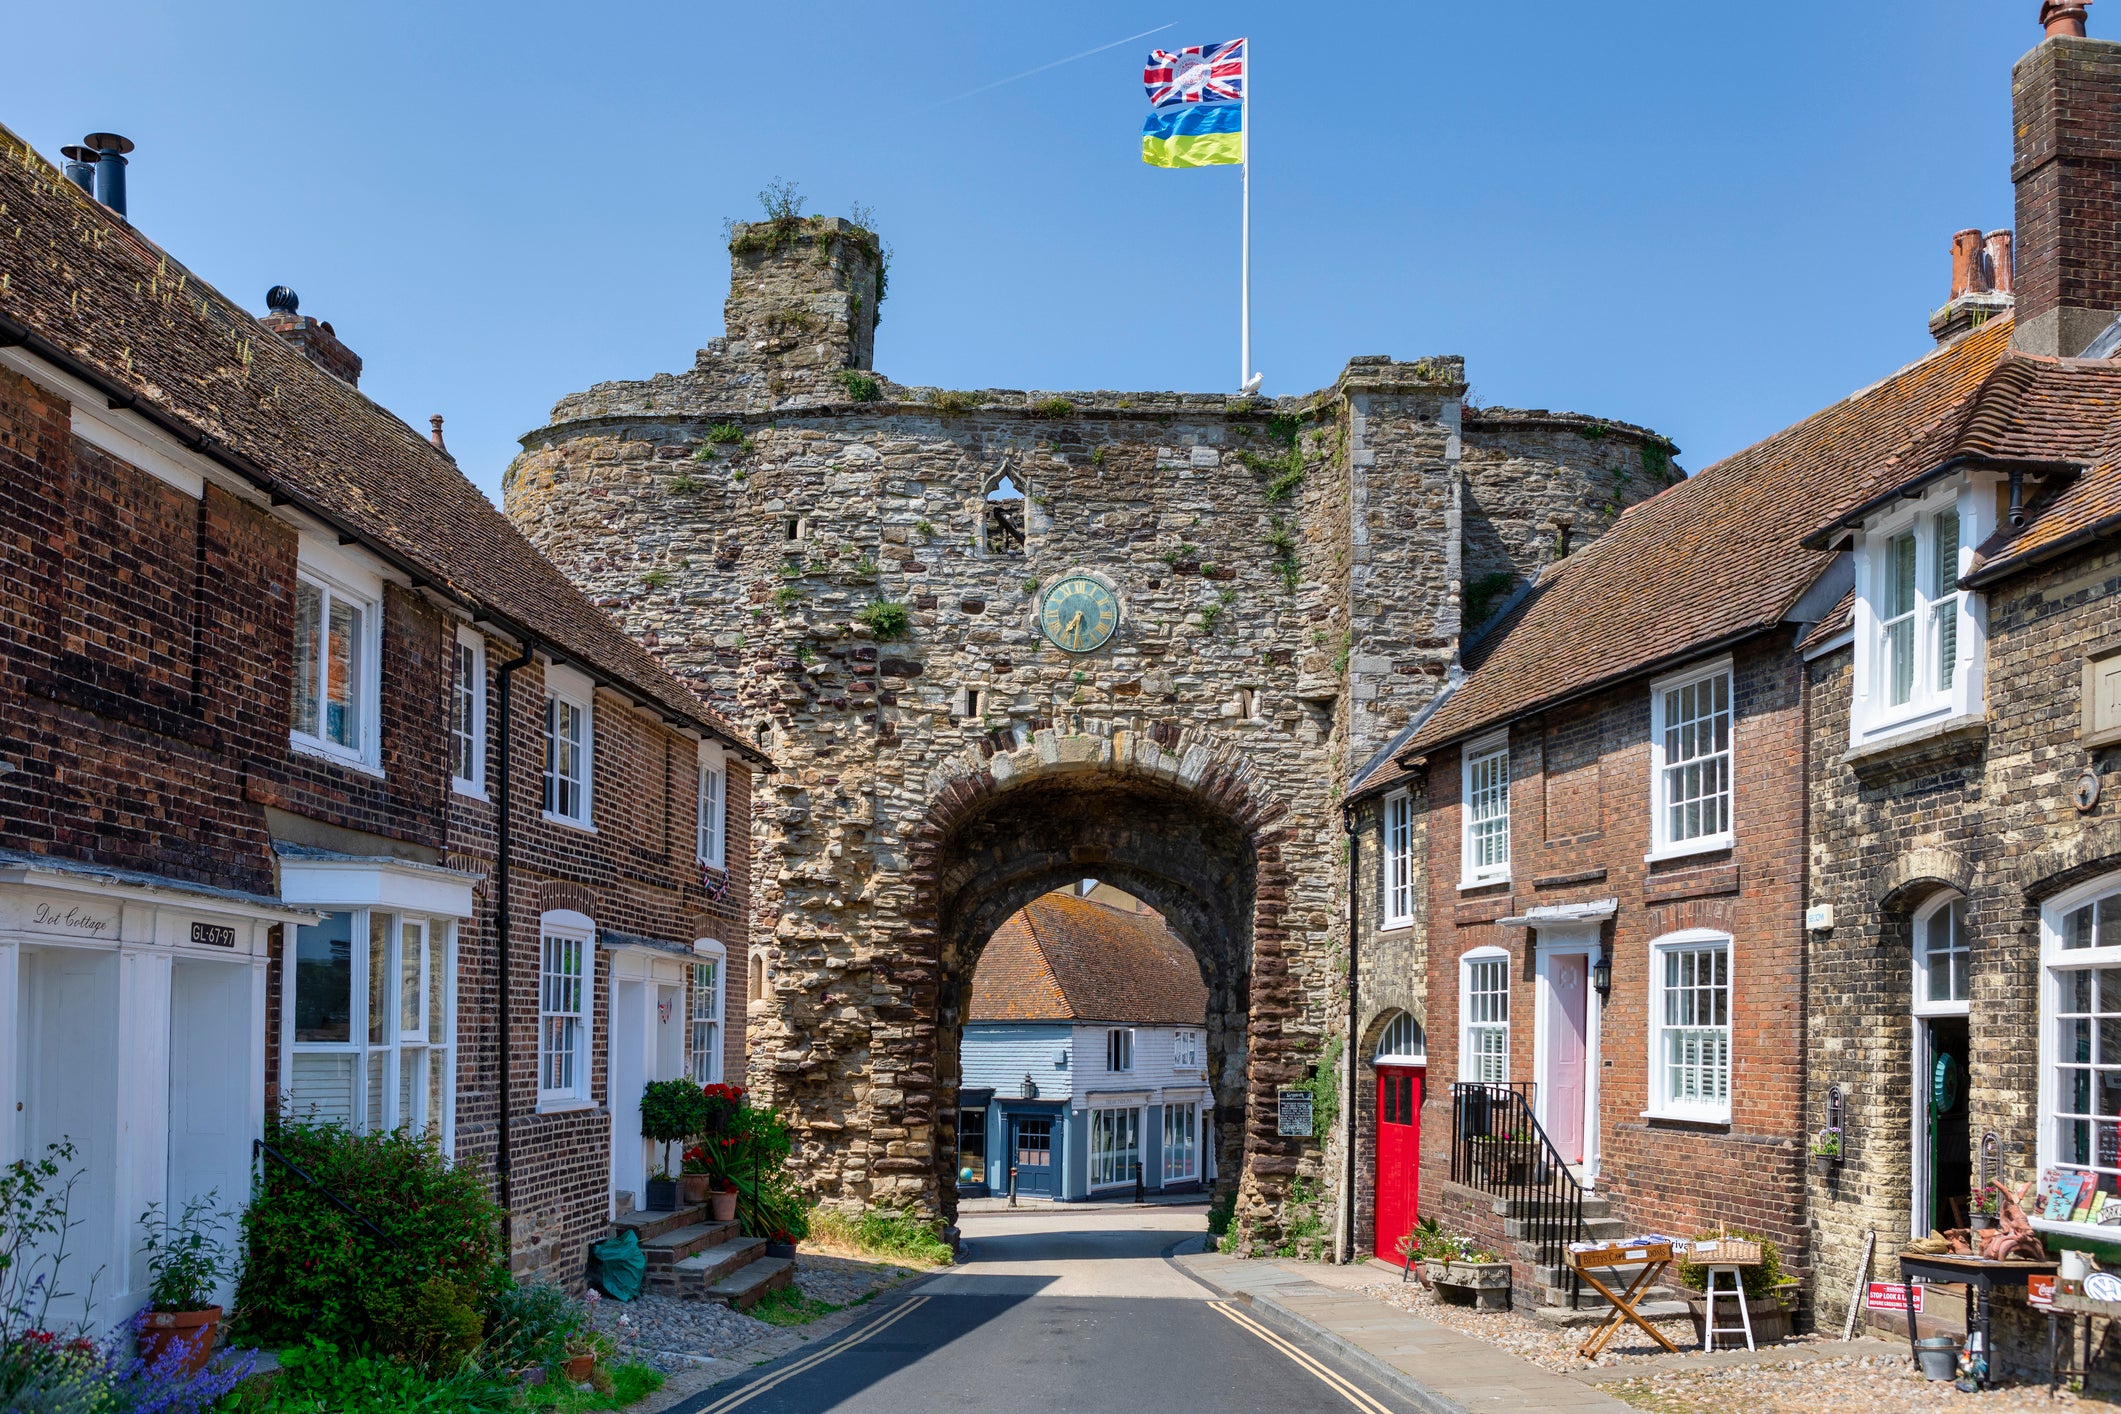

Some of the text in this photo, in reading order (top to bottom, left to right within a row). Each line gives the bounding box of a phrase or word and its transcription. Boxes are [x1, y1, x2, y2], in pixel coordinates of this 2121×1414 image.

[33, 902, 107, 937] Dot Cottage
[1647, 1247, 1666, 1258] OOMS
